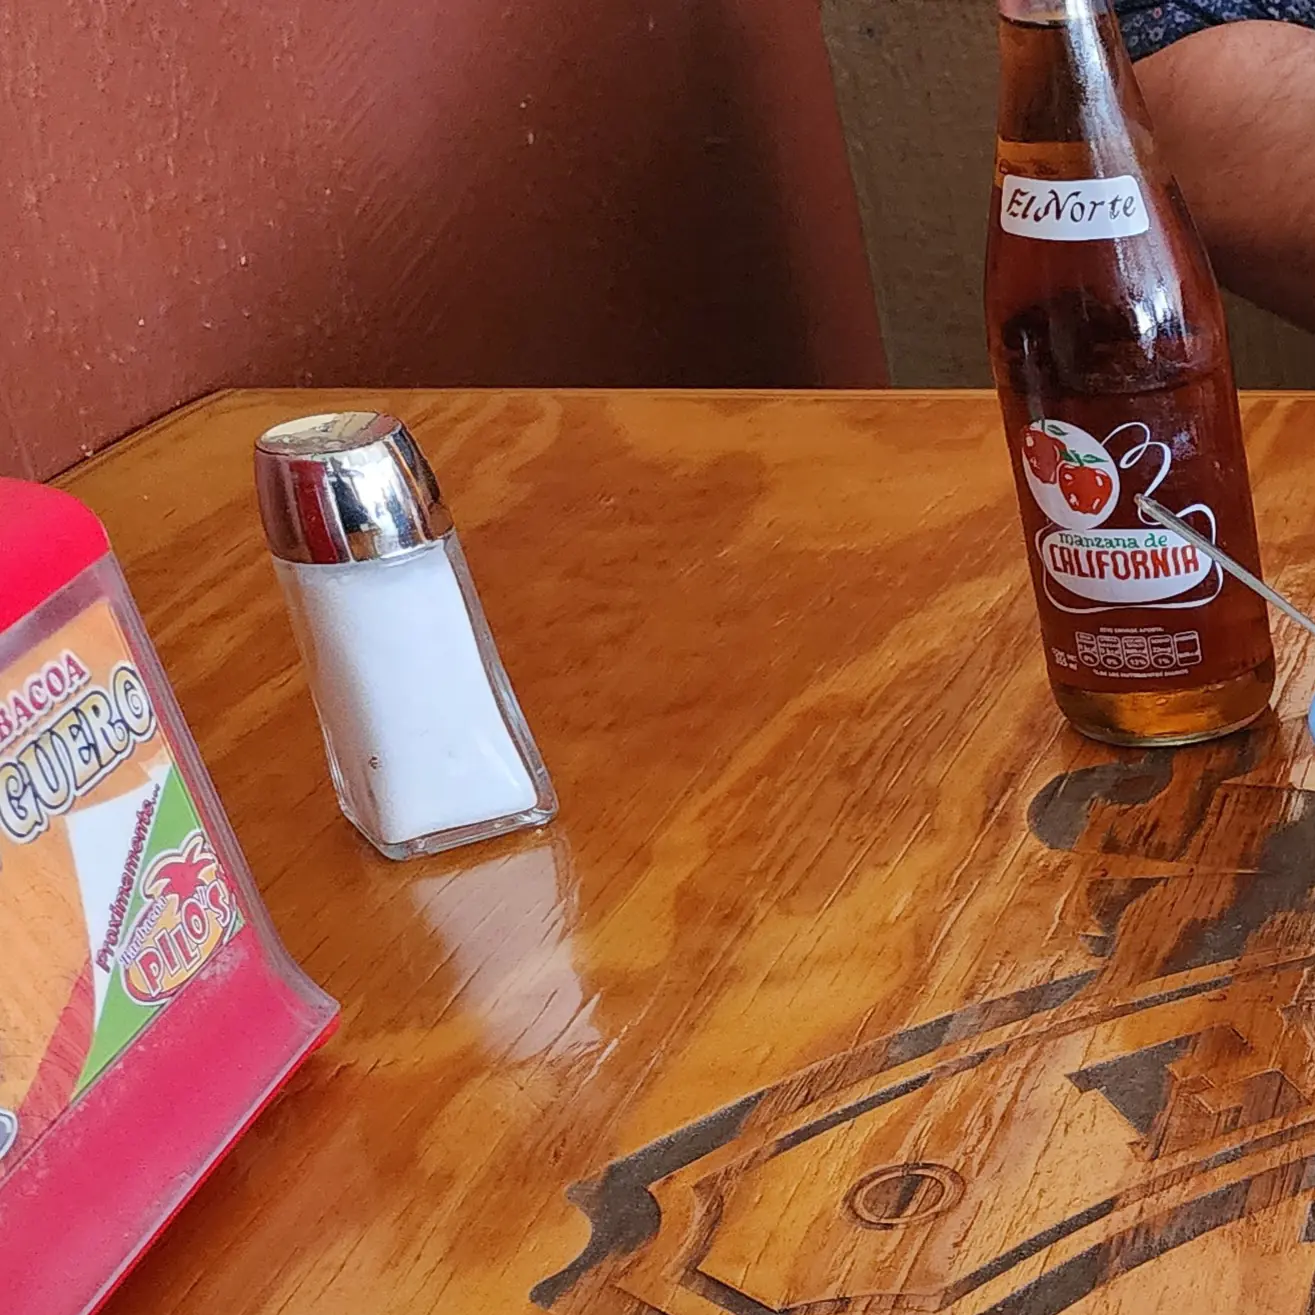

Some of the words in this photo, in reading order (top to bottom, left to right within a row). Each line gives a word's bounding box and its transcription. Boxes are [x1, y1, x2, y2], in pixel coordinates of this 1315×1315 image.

[1006, 188, 1037, 219] El
[1034, 189, 1137, 223] Norte
[1058, 532, 1139, 549] manzana
[1144, 532, 1169, 547] de
[1048, 543, 1201, 581] CALIFORNIA
